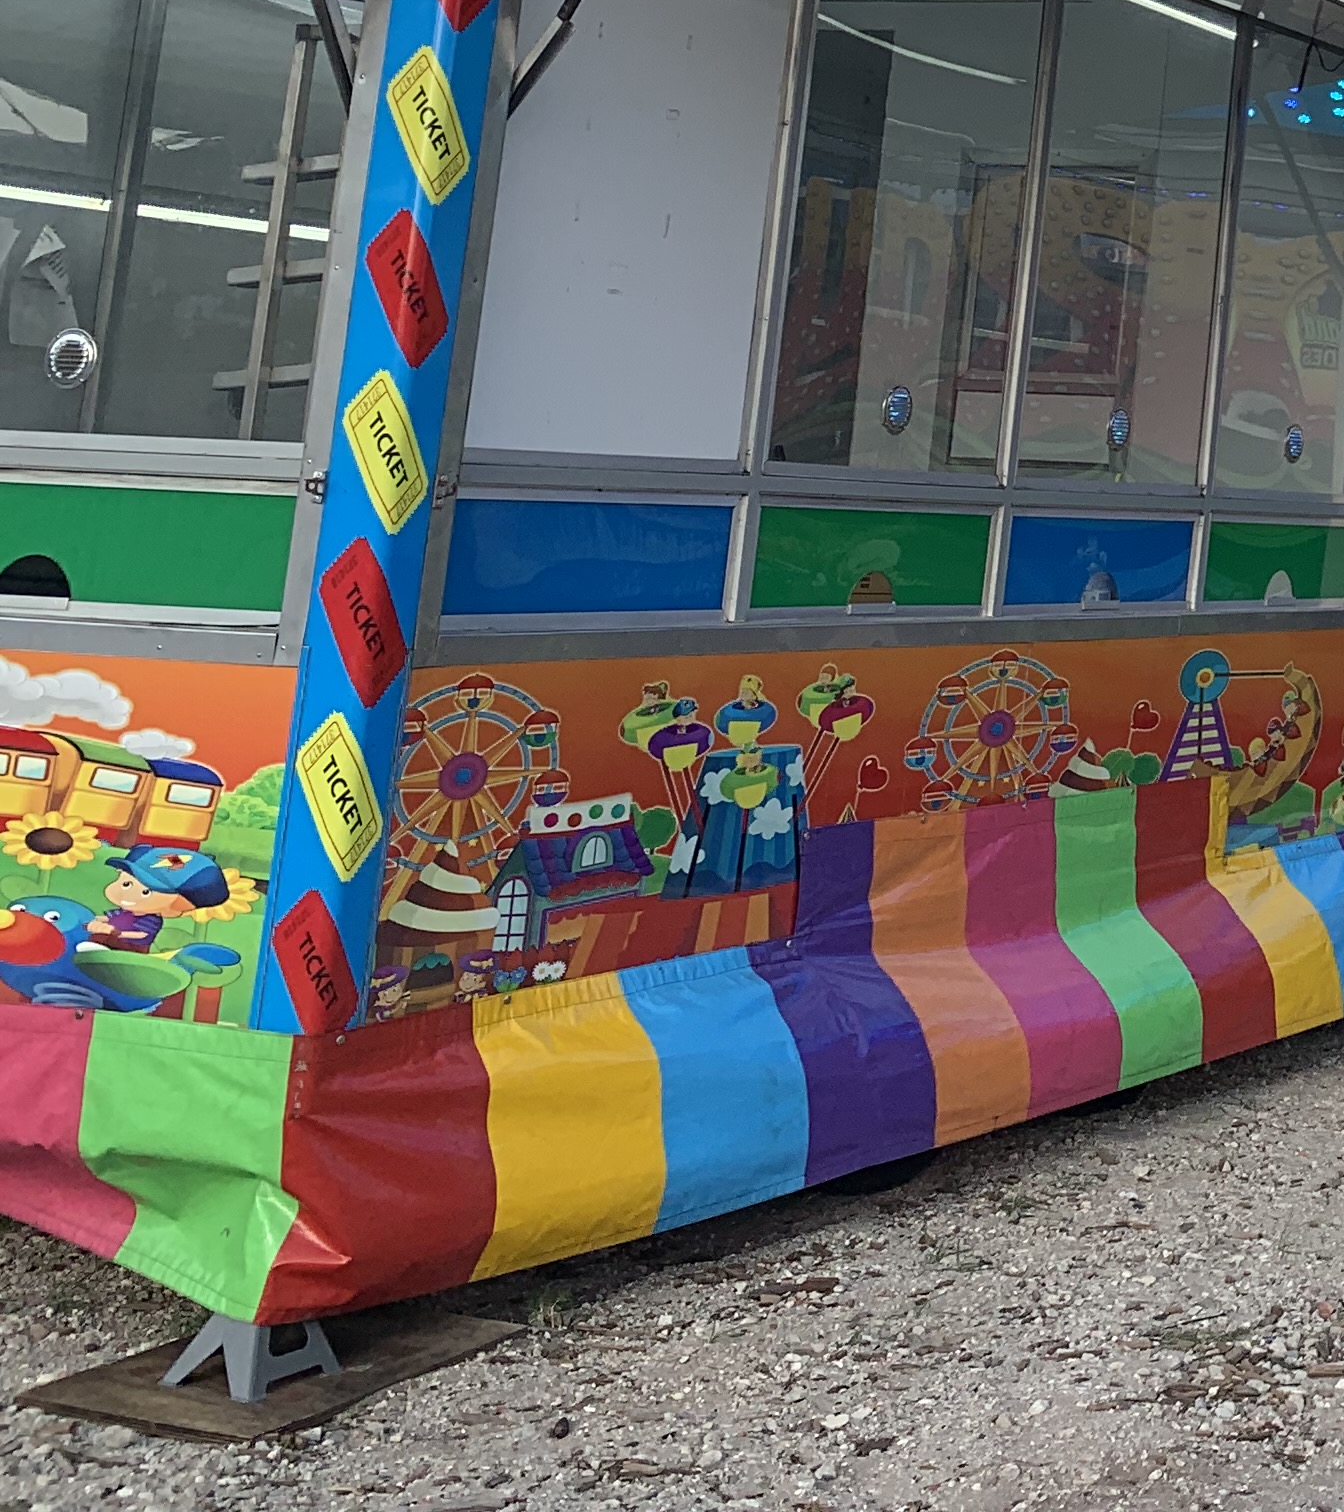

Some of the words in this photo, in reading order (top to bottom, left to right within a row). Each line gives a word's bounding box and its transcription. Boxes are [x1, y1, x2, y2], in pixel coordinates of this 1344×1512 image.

[411, 86, 450, 162] TICKET
[388, 248, 427, 325] TICKET
[370, 410, 407, 489] TICKET
[345, 580, 386, 663] TICKET
[322, 754, 362, 835] TICKET
[298, 935, 337, 1014] TICKET
